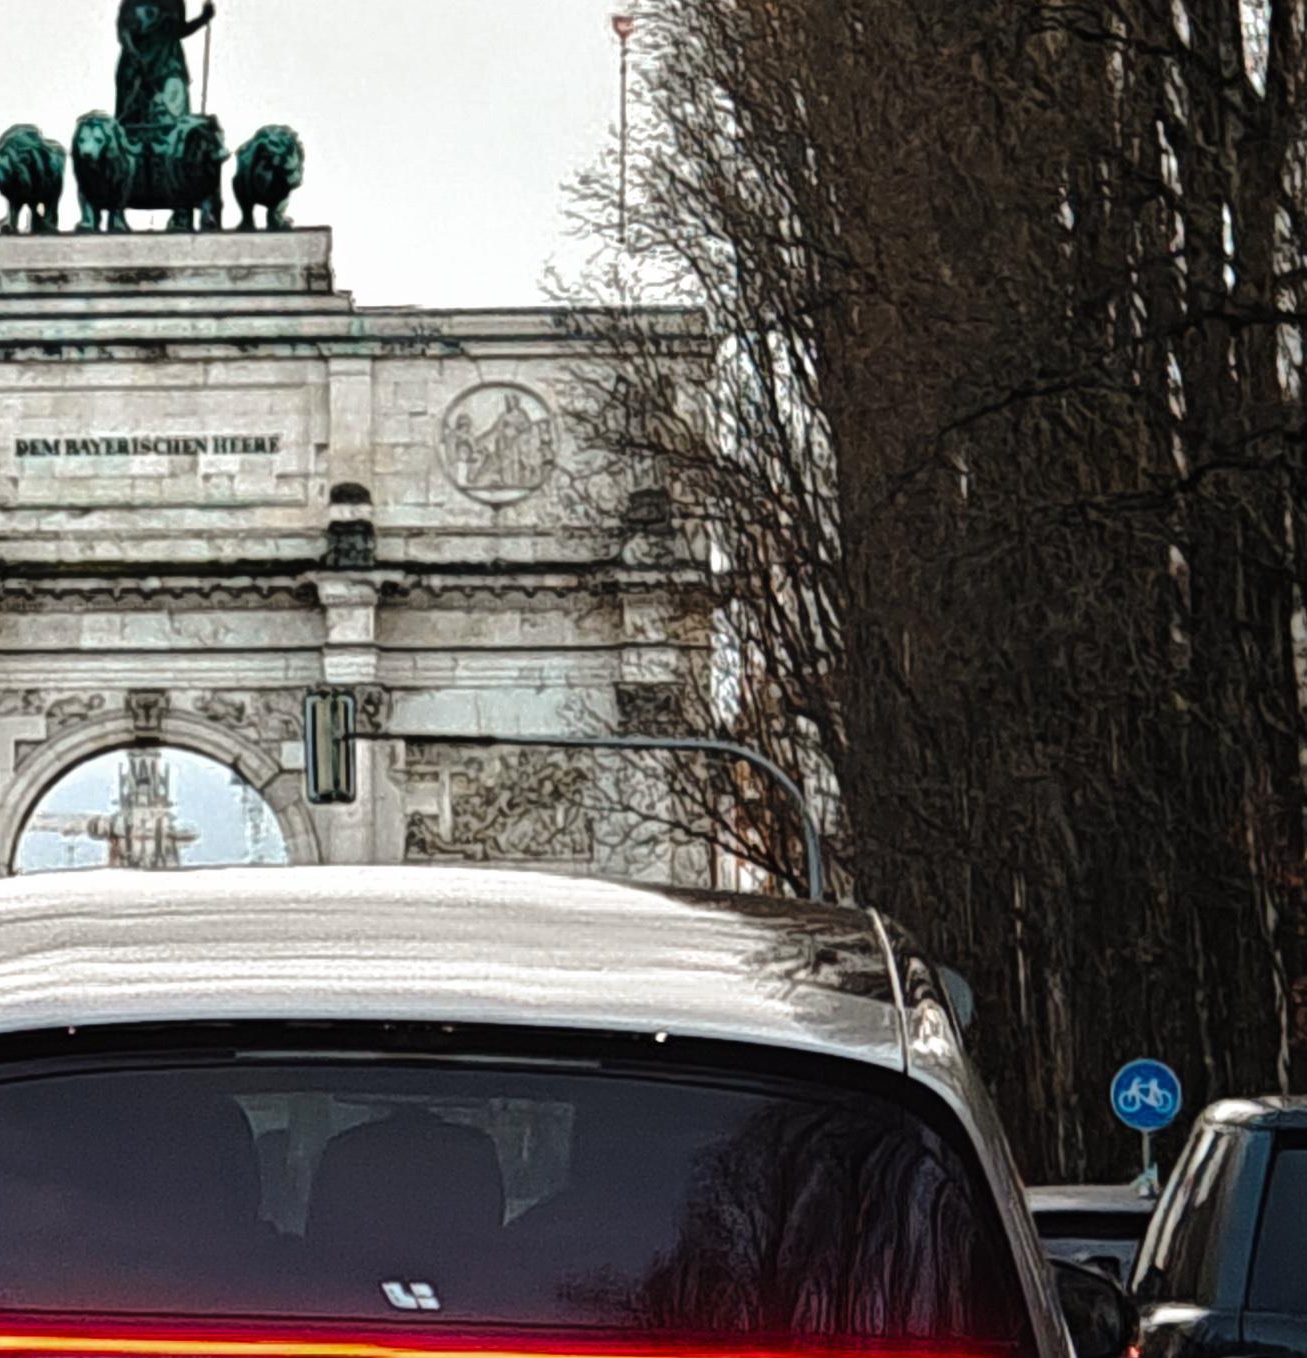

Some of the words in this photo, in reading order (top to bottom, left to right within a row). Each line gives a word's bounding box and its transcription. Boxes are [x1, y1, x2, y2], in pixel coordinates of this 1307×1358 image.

[15, 437, 61, 457] DEM
[64, 436, 208, 457] BAYERISCHEN
[211, 434, 283, 456] HEERE
